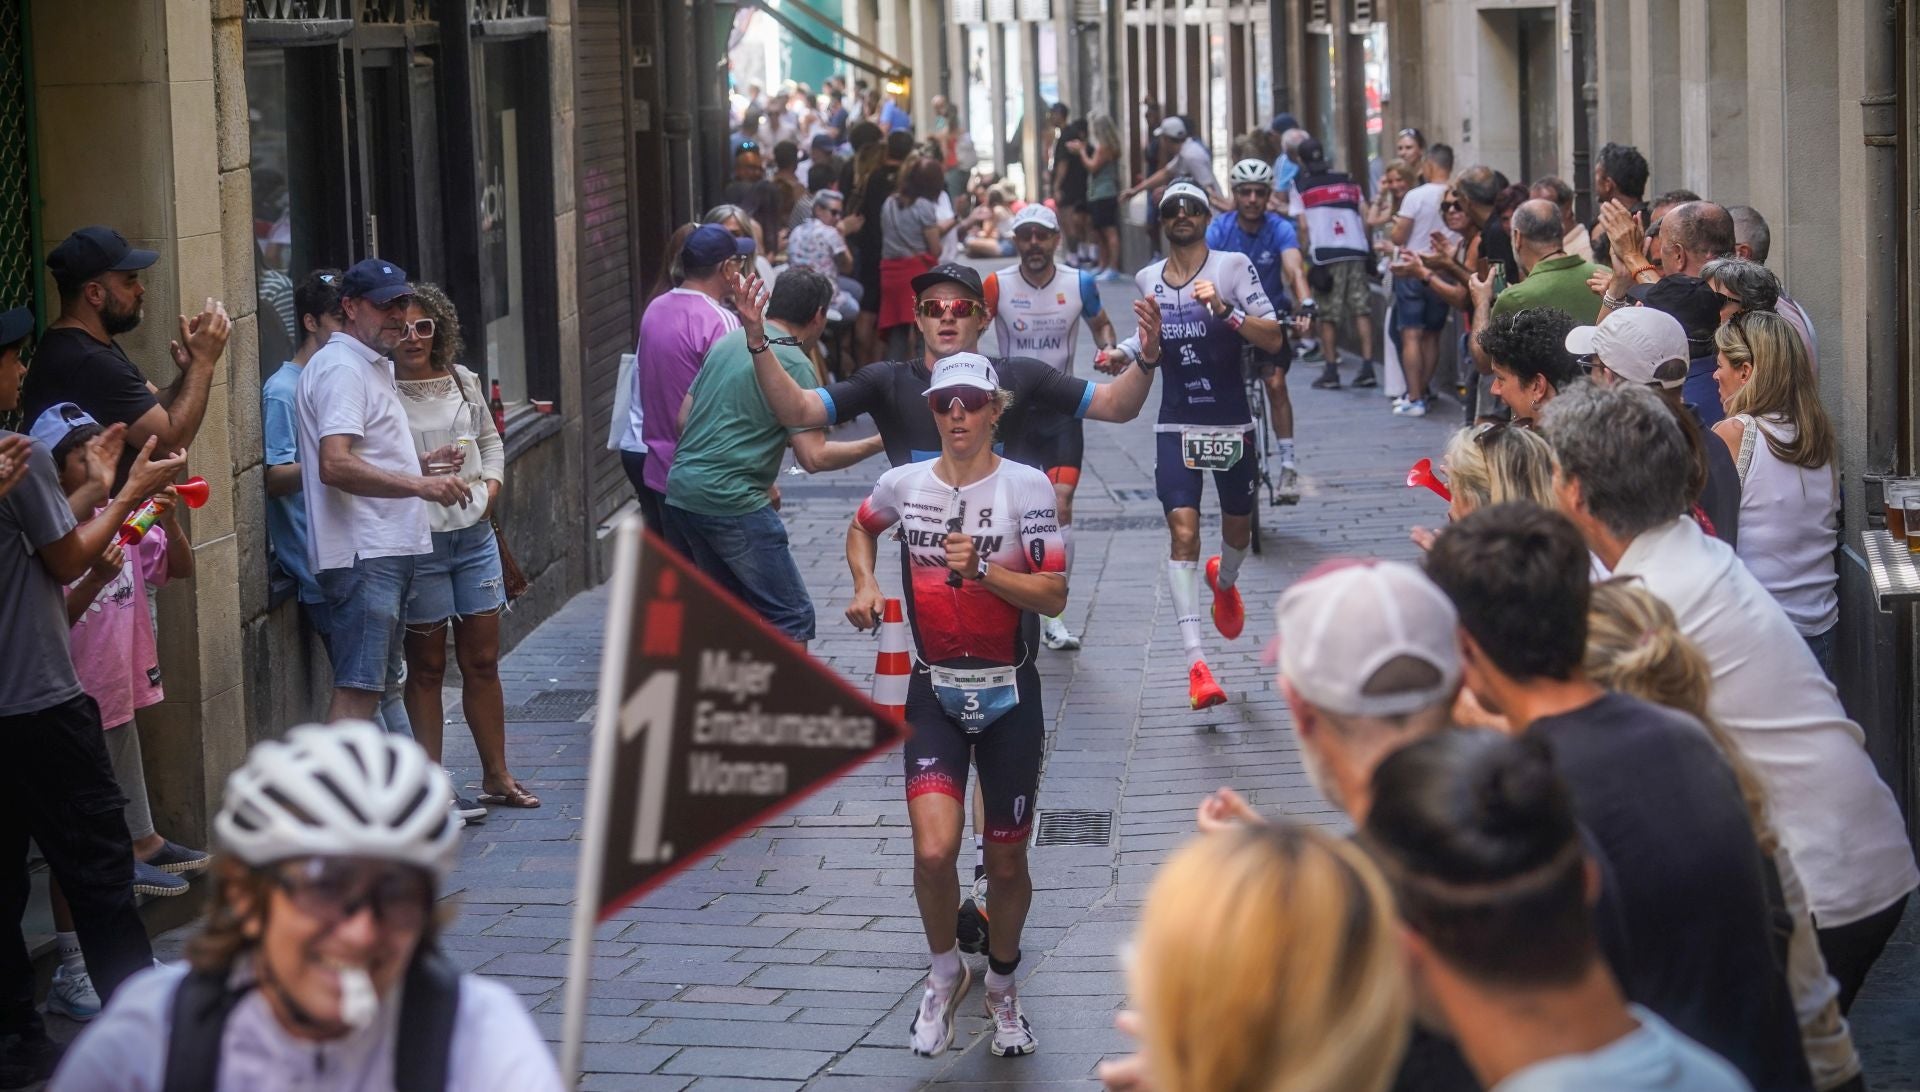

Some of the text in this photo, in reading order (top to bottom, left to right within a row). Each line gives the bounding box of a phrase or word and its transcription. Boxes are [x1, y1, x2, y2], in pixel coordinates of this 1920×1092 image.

[1161, 321, 1207, 340] SERRANO
[942, 363, 975, 373] MNSTRY
[1193, 441, 1234, 455] 1505
[1201, 454, 1226, 462] Antonio
[911, 502, 944, 513] MNSTRY
[1021, 523, 1057, 535] Adecco
[909, 529, 1004, 553] DERON
[699, 649, 776, 703] Mujer
[963, 691, 980, 711] 3
[961, 711, 985, 720] Julie
[693, 700, 878, 748] Emakumezkoa
[687, 752, 789, 795] Woman
